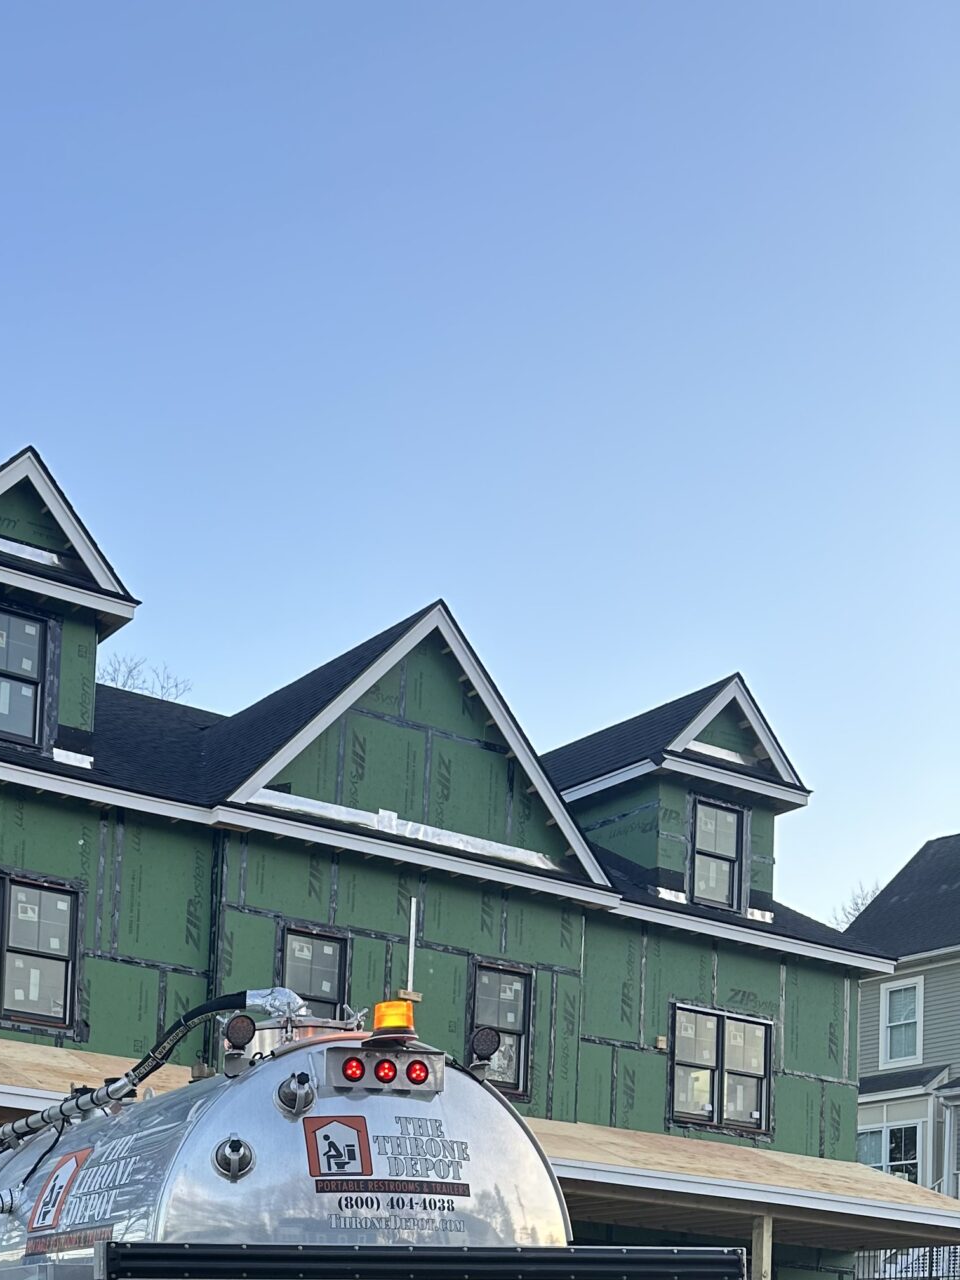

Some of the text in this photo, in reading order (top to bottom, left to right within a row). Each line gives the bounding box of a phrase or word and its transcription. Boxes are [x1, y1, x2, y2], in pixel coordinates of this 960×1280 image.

[395, 1116, 444, 1138] THE
[373, 1135, 470, 1161] THRONE
[387, 1156, 463, 1180] DEPOT
[317, 1180, 365, 1192] PORTABLE
[368, 1181, 420, 1193] RESTROOMS
[432, 1184, 469, 1196] TRAILERS
[338, 1196, 455, 1212] (800) 404-4038
